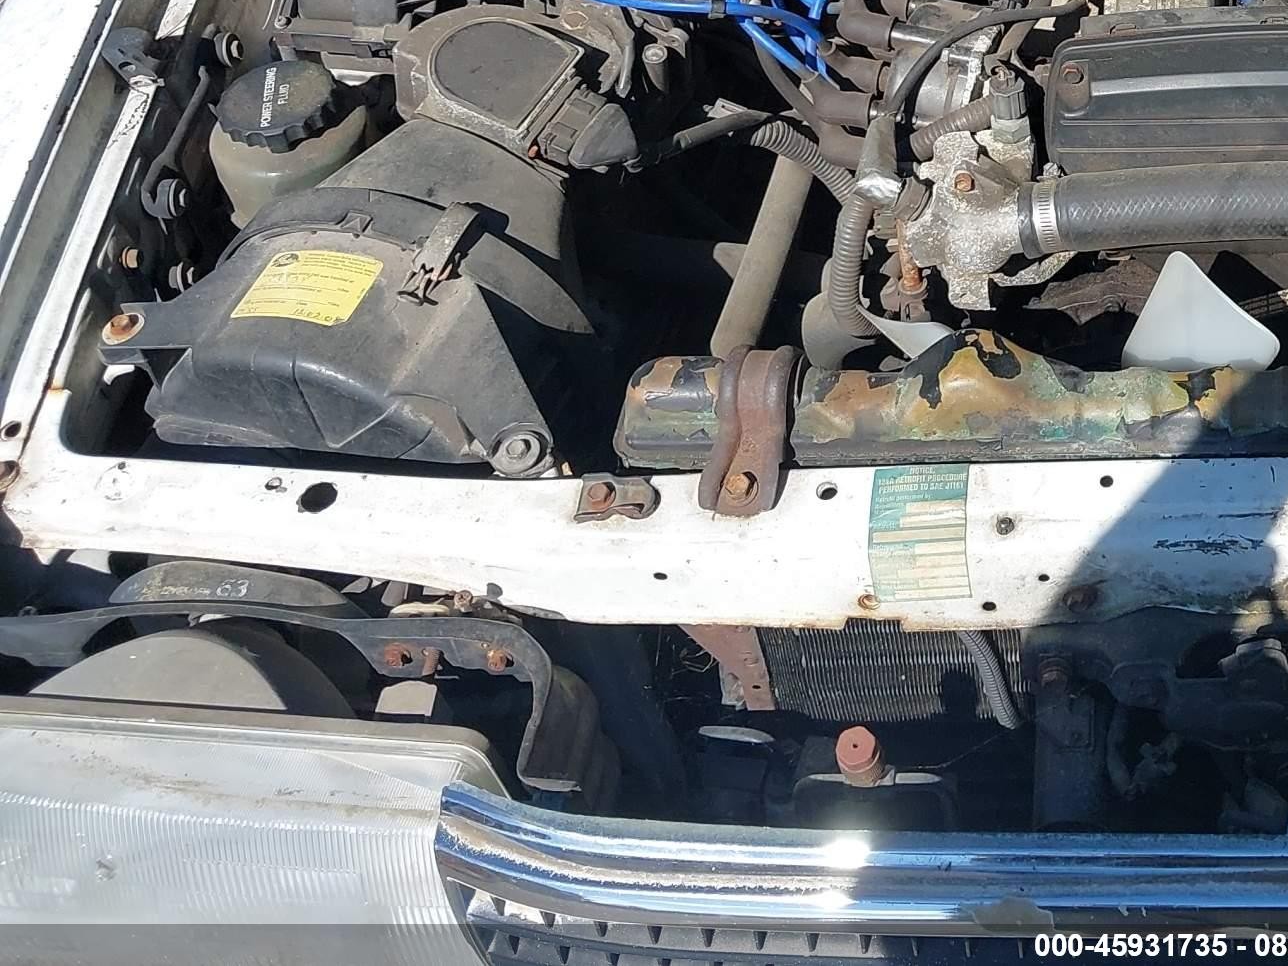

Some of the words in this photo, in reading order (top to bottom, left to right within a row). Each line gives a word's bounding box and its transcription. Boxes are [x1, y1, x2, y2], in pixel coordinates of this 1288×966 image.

[263, 67, 277, 102] STEERING
[277, 84, 290, 105] FLUID
[260, 101, 273, 128] POWER
[878, 483, 919, 494] PERFORMED
[919, 483, 929, 491] TO
[215, 577, 251, 598] 63
